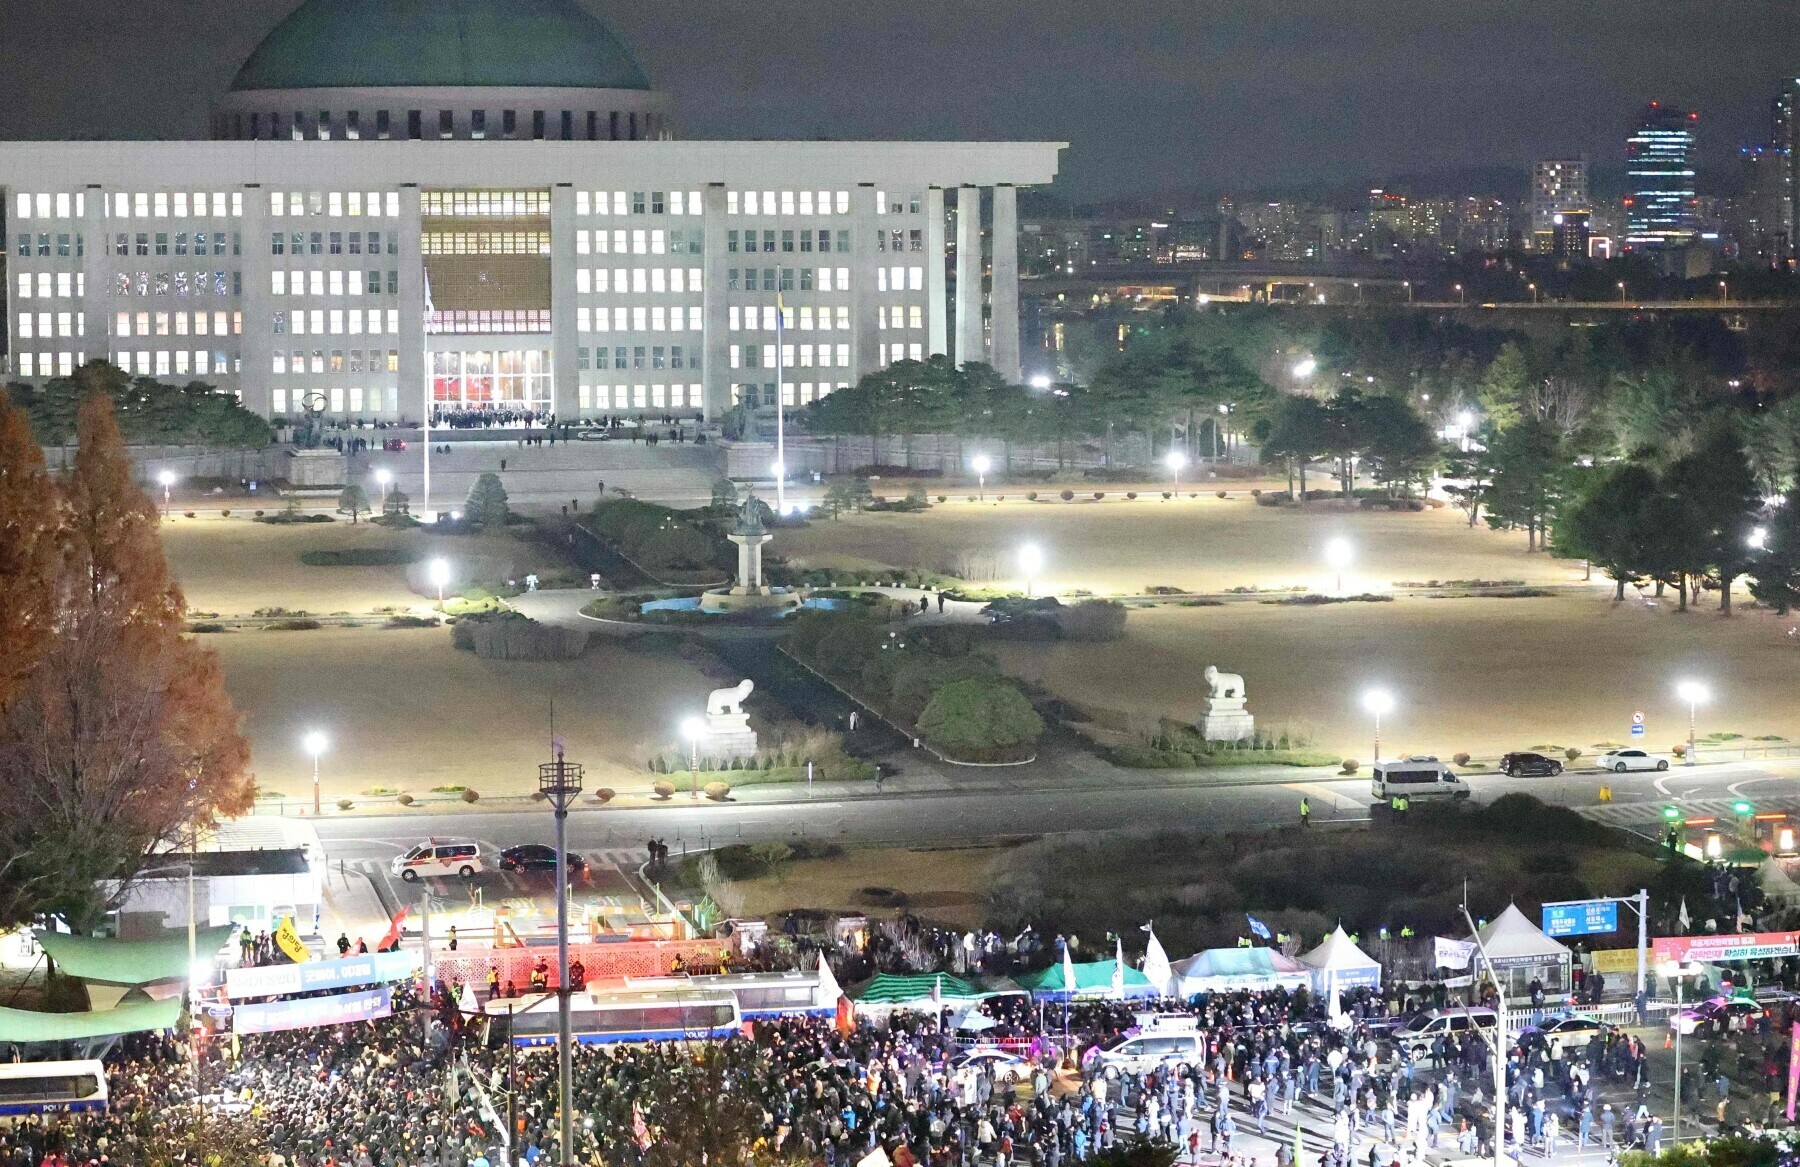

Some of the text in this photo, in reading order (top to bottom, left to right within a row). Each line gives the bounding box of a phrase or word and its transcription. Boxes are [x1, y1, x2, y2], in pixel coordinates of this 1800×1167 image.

[1689, 946, 1800, 959] 과학인재 확실히 육성하겠습니
